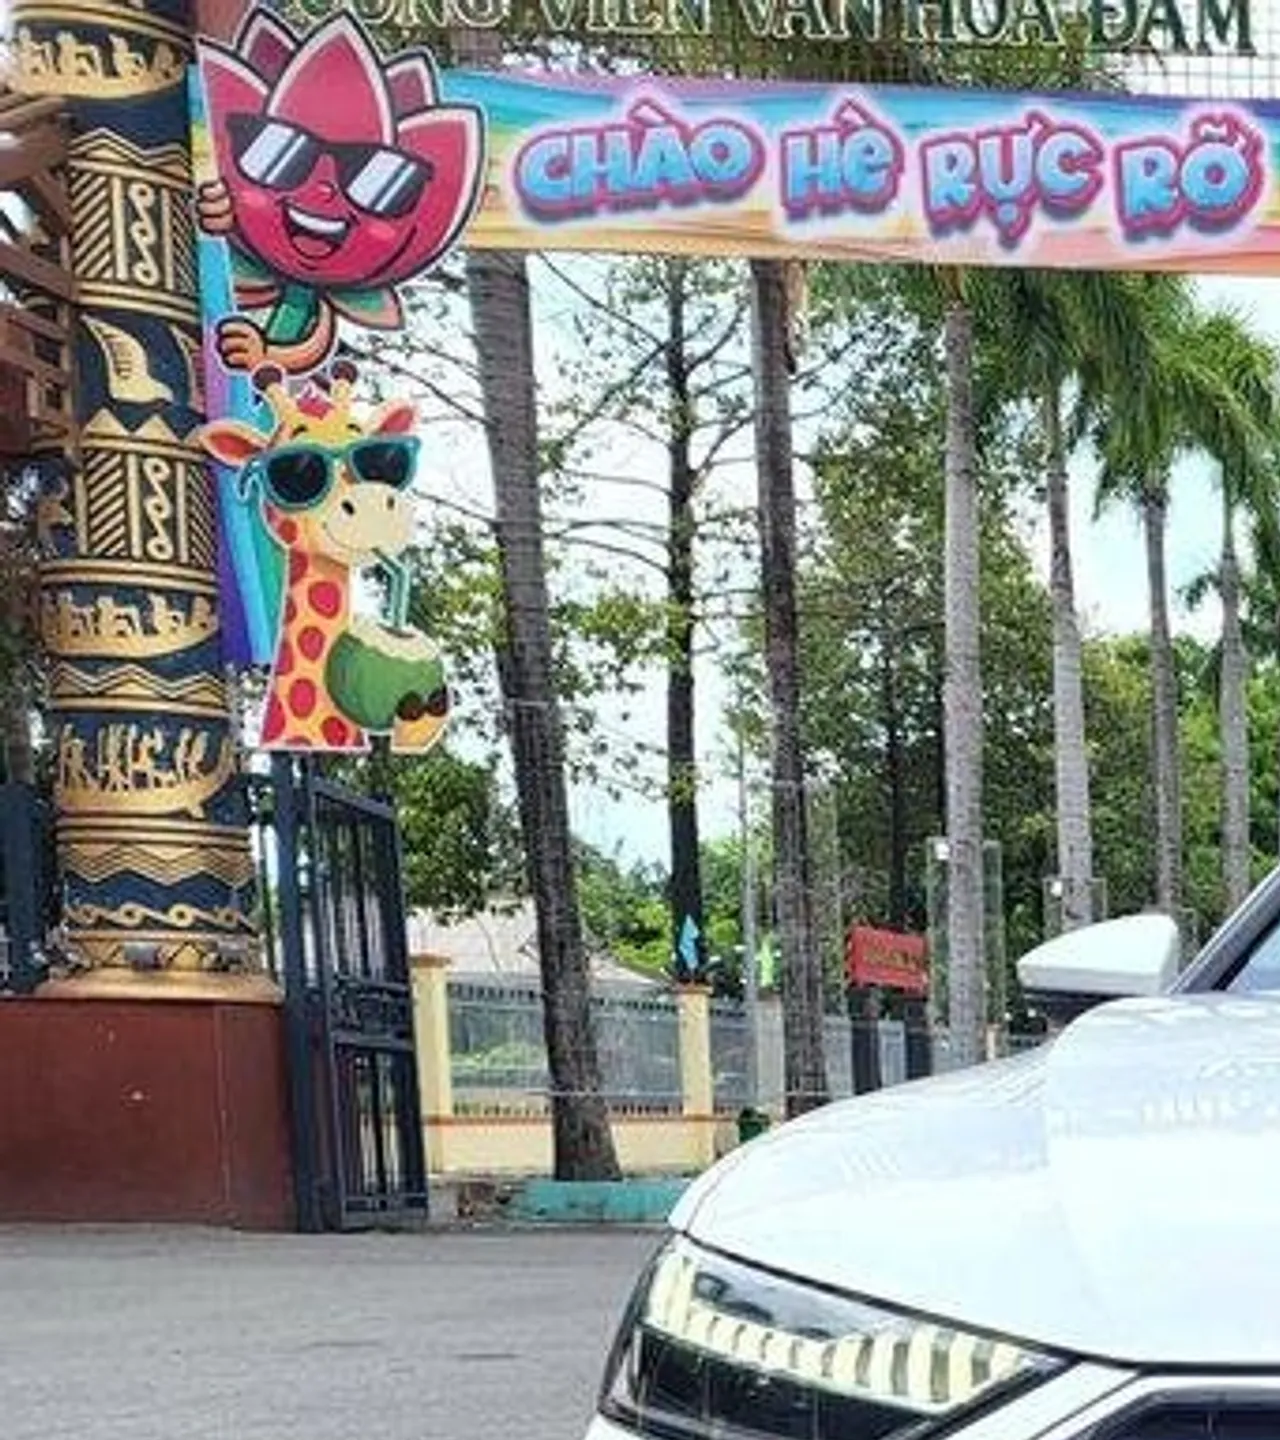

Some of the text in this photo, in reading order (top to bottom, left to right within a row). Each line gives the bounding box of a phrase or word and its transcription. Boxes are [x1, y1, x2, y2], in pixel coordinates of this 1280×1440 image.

[515, 99, 765, 216] CHÀO
[920, 111, 1102, 242] RỰC
[1115, 114, 1263, 238] RỠ
